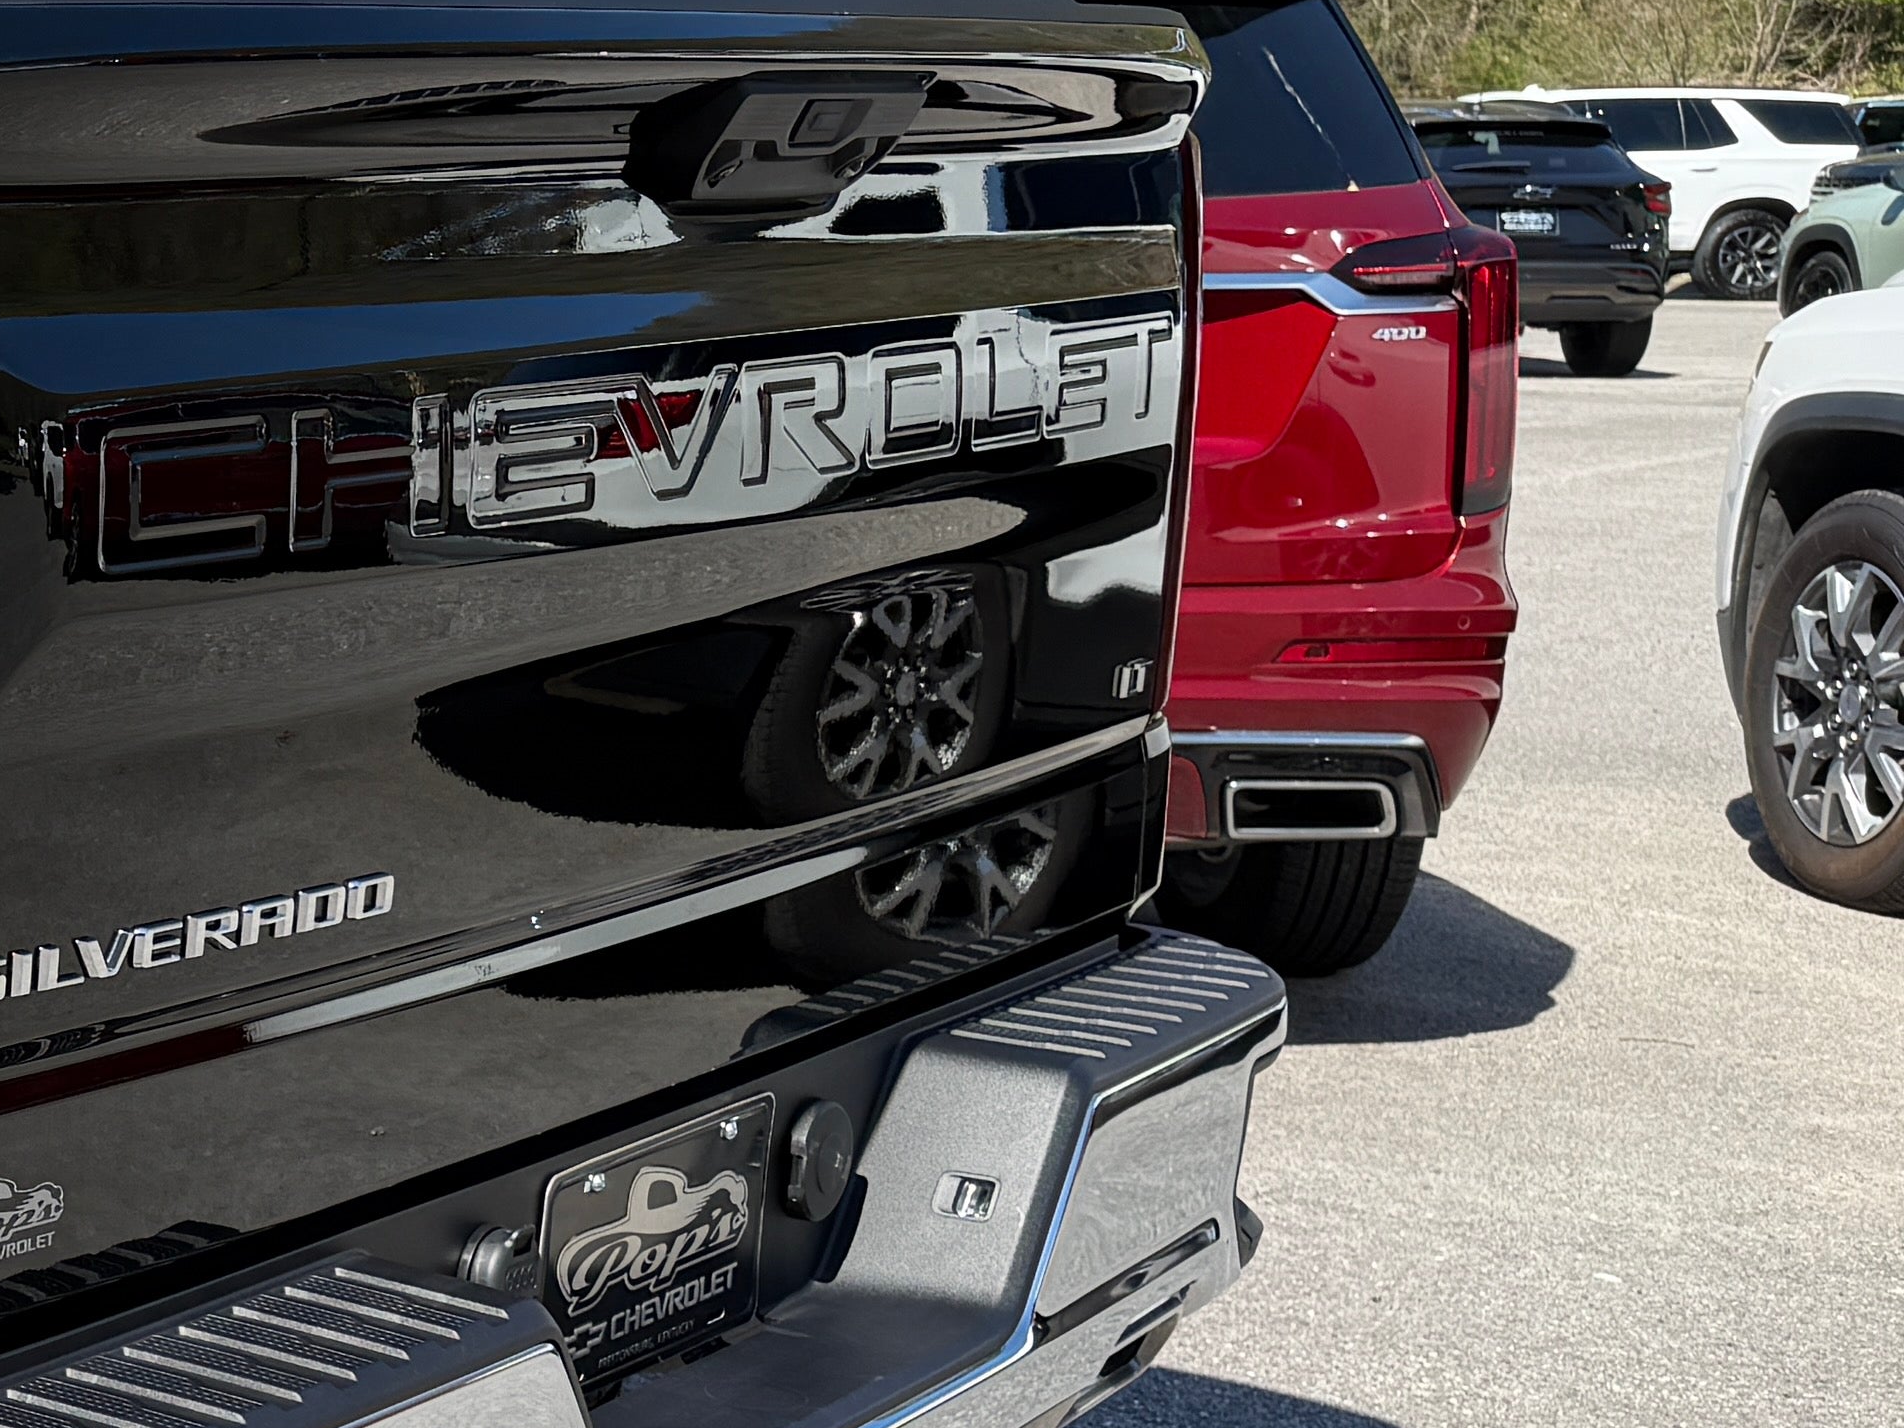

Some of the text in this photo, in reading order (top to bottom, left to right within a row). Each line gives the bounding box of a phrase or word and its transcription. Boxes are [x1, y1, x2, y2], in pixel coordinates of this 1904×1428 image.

[1371, 326, 1427, 342] 400
[97, 310, 1176, 573] CHEVROLET
[610, 1261, 738, 1341] CHEVROLET
